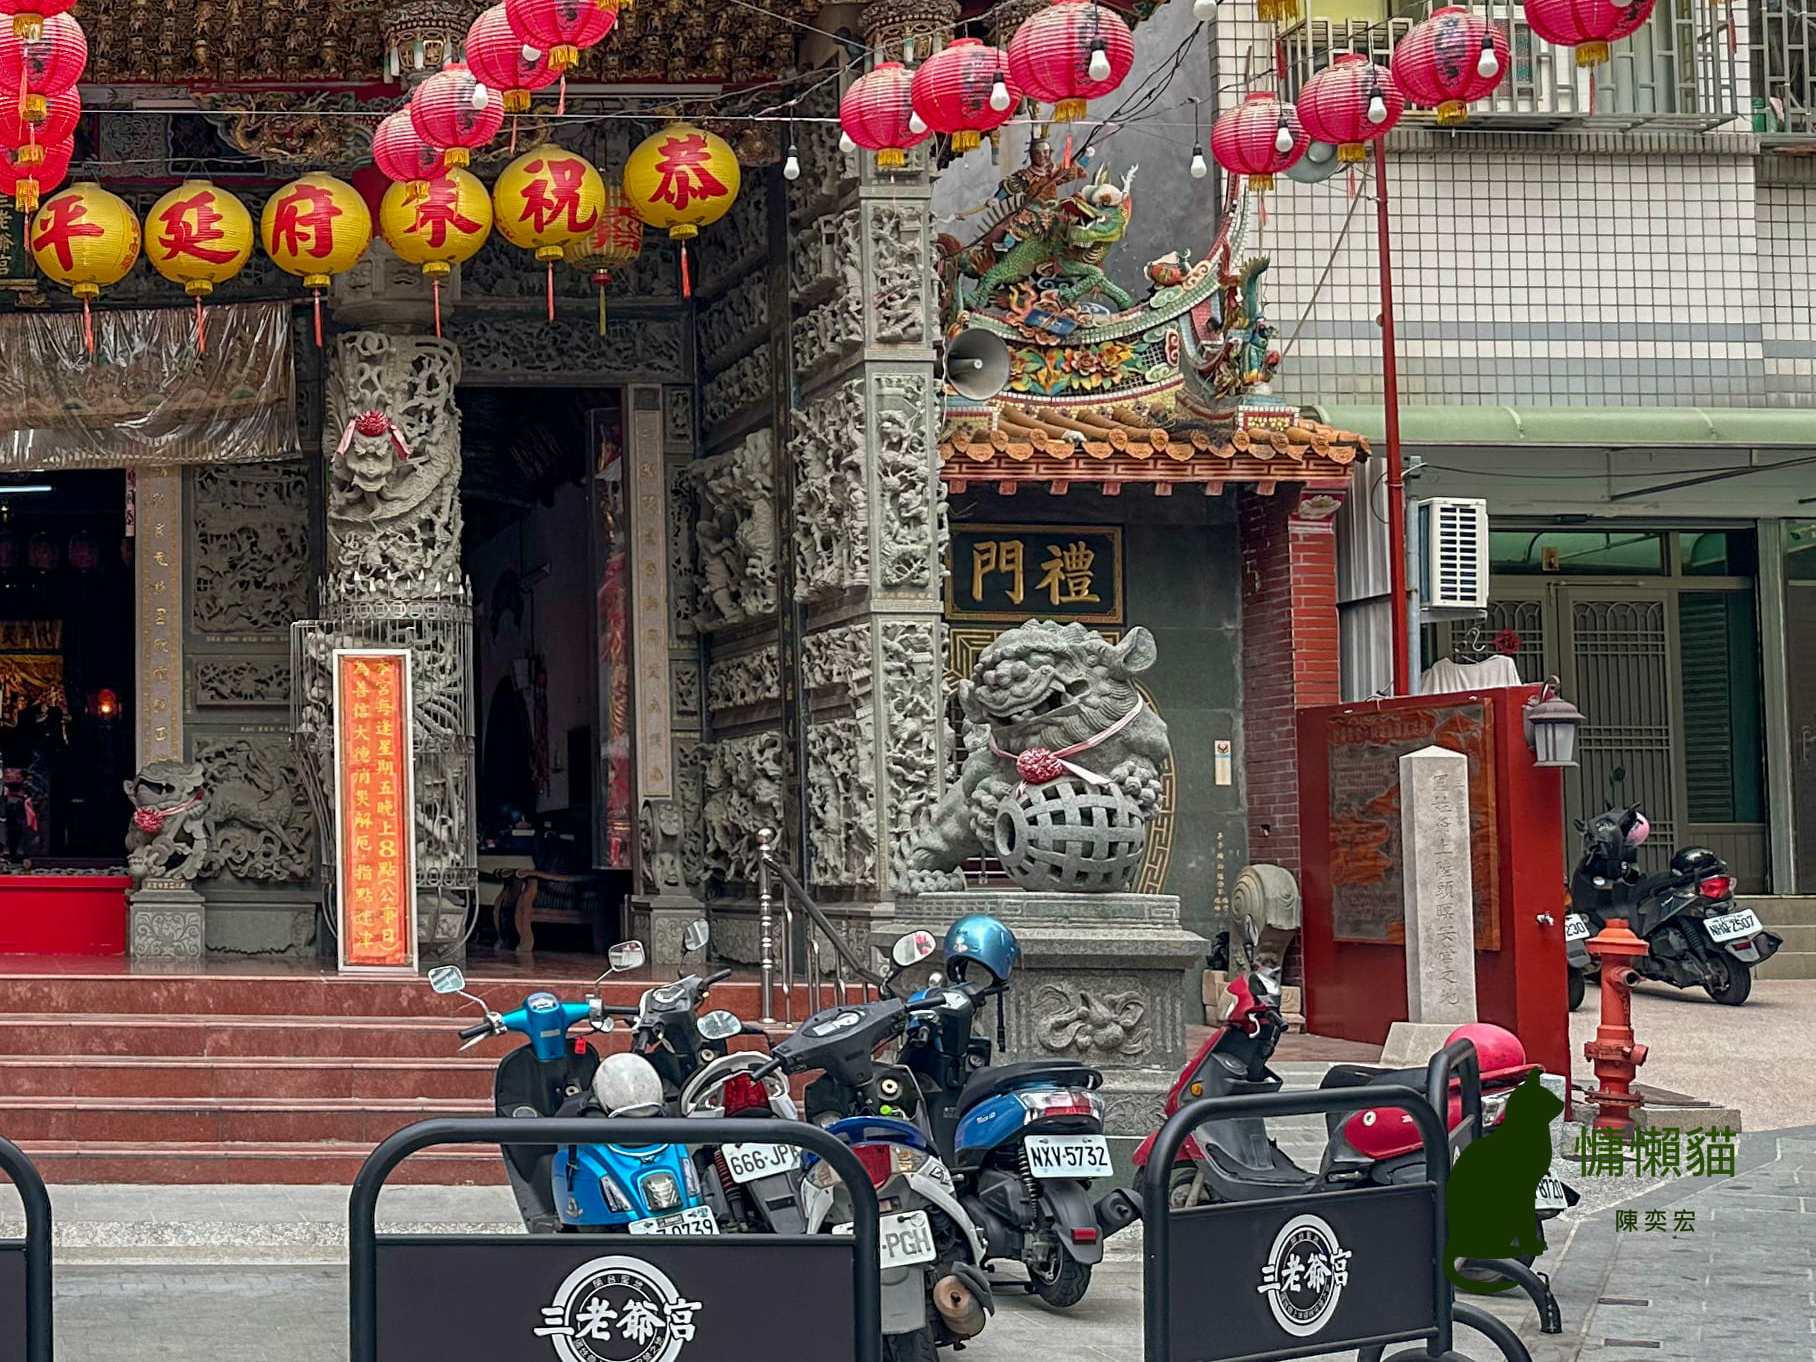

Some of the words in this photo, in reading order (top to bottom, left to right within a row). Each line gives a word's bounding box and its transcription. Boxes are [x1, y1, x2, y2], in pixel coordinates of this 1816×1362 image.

[519, 159, 598, 233] 祝
[648, 134, 728, 210] 恭
[34, 195, 105, 271] 平
[158, 191, 240, 264] 延
[272, 184, 342, 257] 府
[971, 539, 1101, 606] 禮門
[1565, 922, 1585, 936] 230
[1031, 1146, 1108, 1167] NXV-5732
[882, 1228, 931, 1258] -PGH
[1257, 1248, 1352, 1293] 三老爺宮
[533, 1297, 702, 1345] 三老爺宮
